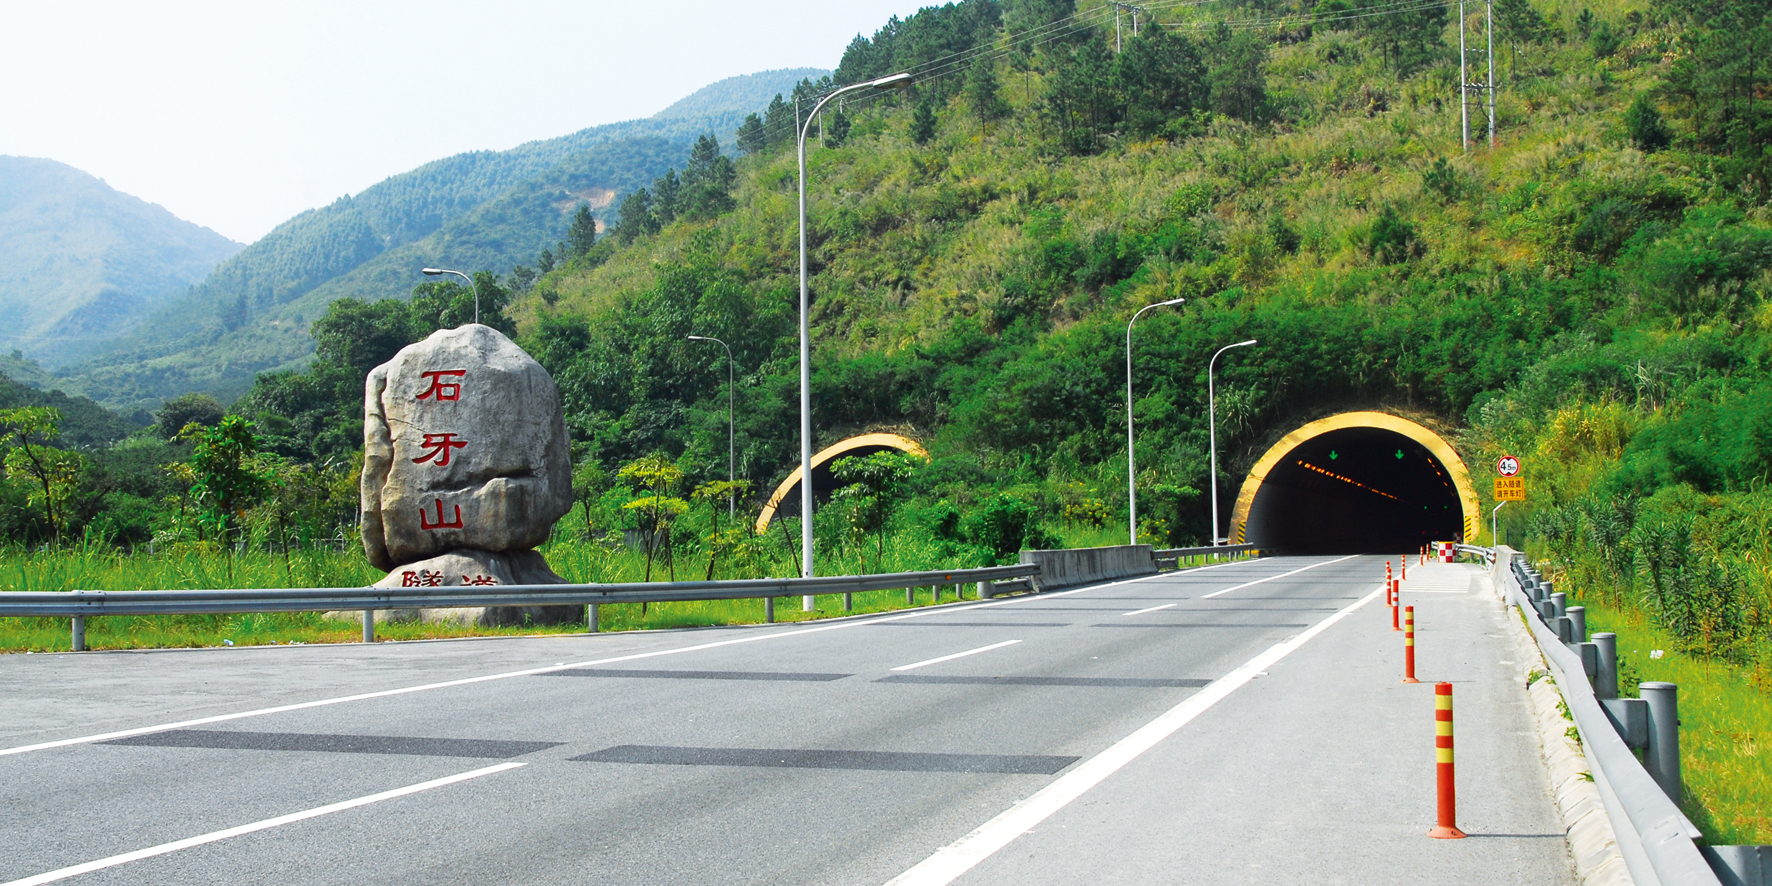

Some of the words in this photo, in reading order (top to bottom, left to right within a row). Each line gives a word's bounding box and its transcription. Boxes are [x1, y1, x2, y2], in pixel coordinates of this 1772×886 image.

[412, 369, 468, 530] 石牙山
[1496, 480, 1521, 488] 进入隧道
[1497, 490, 1522, 498] 请开车灯
